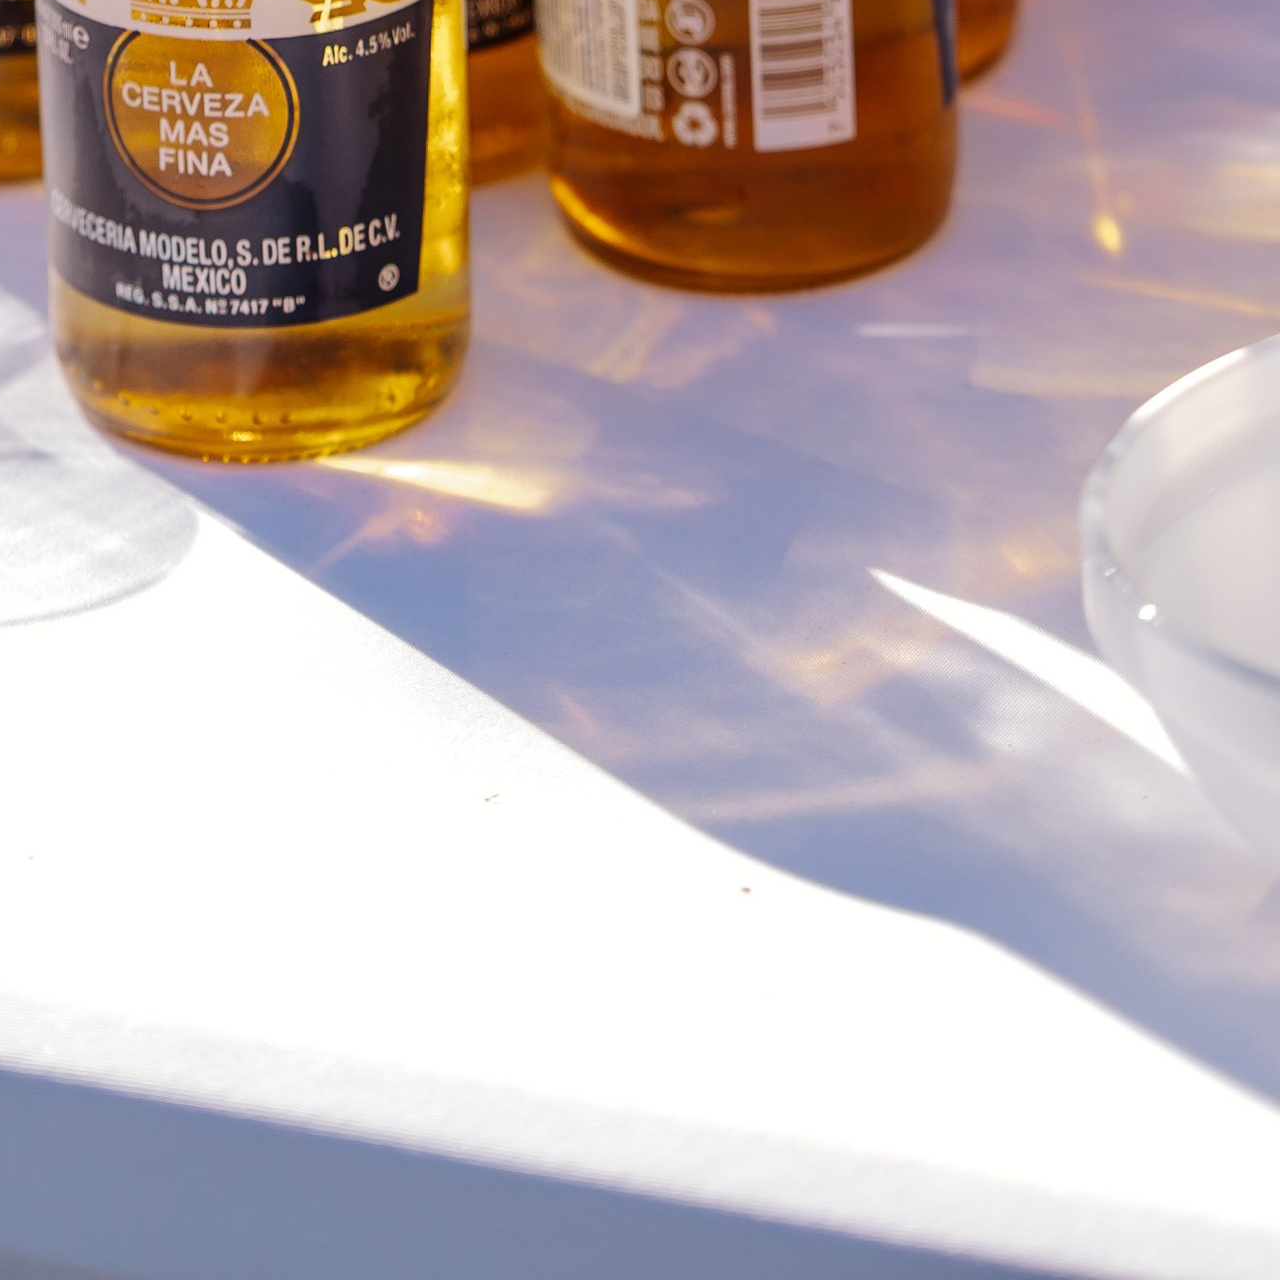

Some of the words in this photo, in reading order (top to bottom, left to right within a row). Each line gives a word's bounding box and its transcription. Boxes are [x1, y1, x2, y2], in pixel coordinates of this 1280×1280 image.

[322, 43, 354, 67] Alc.
[391, 21, 416, 45] Vol.
[169, 60, 214, 88] LA
[121, 81, 270, 119] CERVEZA
[159, 116, 230, 148] MAS
[158, 146, 233, 178] FINA
[48, 188, 138, 254] VECERIA
[138, 228, 234, 270] MODELO,
[236, 238, 259, 267] S.
[262, 236, 292, 266] DE
[296, 231, 339, 263] R.L.
[338, 223, 367, 256] DE
[368, 212, 401, 247] C.V.
[162, 262, 248, 296] MEXICO
[115, 281, 150, 307] REG.
[151, 290, 203, 315] S.S.A.
[229, 296, 270, 316] 7417
